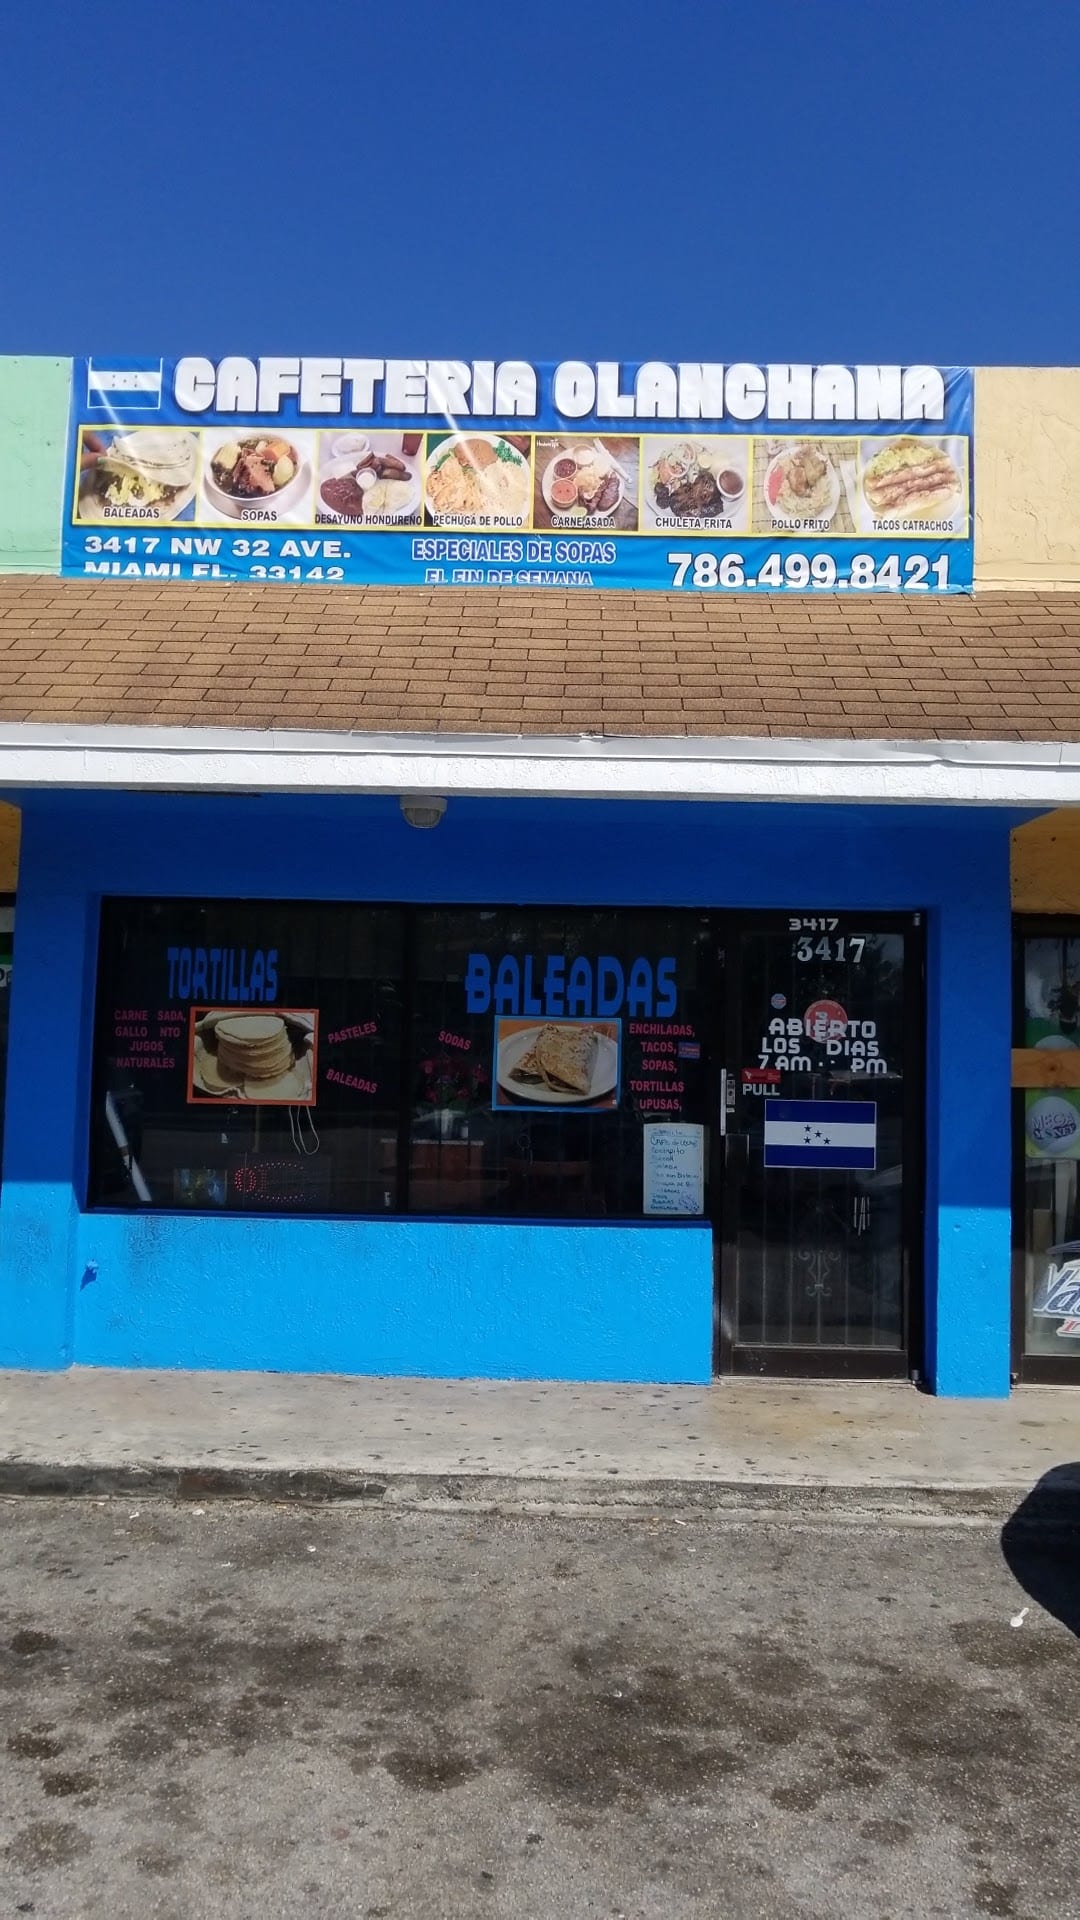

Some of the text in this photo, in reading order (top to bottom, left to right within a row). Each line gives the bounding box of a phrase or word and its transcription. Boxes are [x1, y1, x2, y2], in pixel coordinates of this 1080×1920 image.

[175, 357, 945, 421] CAFETERIA OLANCHANA
[103, 507, 160, 519] BALEADAS
[242, 510, 278, 521] SOPAS
[315, 514, 363, 525] DESAYUNO
[433, 515, 523, 527] PECHUGA DE POLLO
[552, 516, 616, 528] CARNE ASADA
[655, 516, 732, 529] CHULETA FRITA
[771, 518, 830, 530] POLLO FRITO
[872, 520, 954, 531] TACOS CATRACHOS
[84, 536, 351, 559] 3417 NW 32 AVE.
[412, 539, 617, 564] ESPECIALES DE SOPAS
[83, 561, 180, 577] MIAMI
[249, 565, 345, 580] 33142
[425, 569, 594, 586] EL FIN DE SEMANA
[667, 553, 950, 590] 786.499.8421
[789, 918, 839, 931] 3417
[796, 937, 866, 963] 3417
[167, 947, 279, 1002] TORTILLAS
[464, 953, 678, 1018] BALEADAS
[114, 1009, 149, 1021] CARNE
[115, 1026, 149, 1038] GALLO
[327, 1022, 378, 1044] PASTELES
[629, 1023, 695, 1037] ENCHILADAS,
[768, 1017, 877, 1039] ABIERTO
[438, 1030, 471, 1050] SODAS
[761, 1037, 880, 1057] LOS DIAS
[640, 1041, 677, 1055] TACOS,
[116, 1057, 176, 1069] NATURALES
[642, 1059, 678, 1073] SOPAS,
[757, 1055, 769, 1070] 7
[850, 1058, 889, 1074] PM
[326, 1068, 378, 1094] BALEADAS
[630, 1080, 684, 1093] TORTILLAS
[742, 1084, 780, 1096] PULL
[639, 1098, 682, 1113] UPUSAS,
[1031, 1111, 1075, 1128] MEGA
